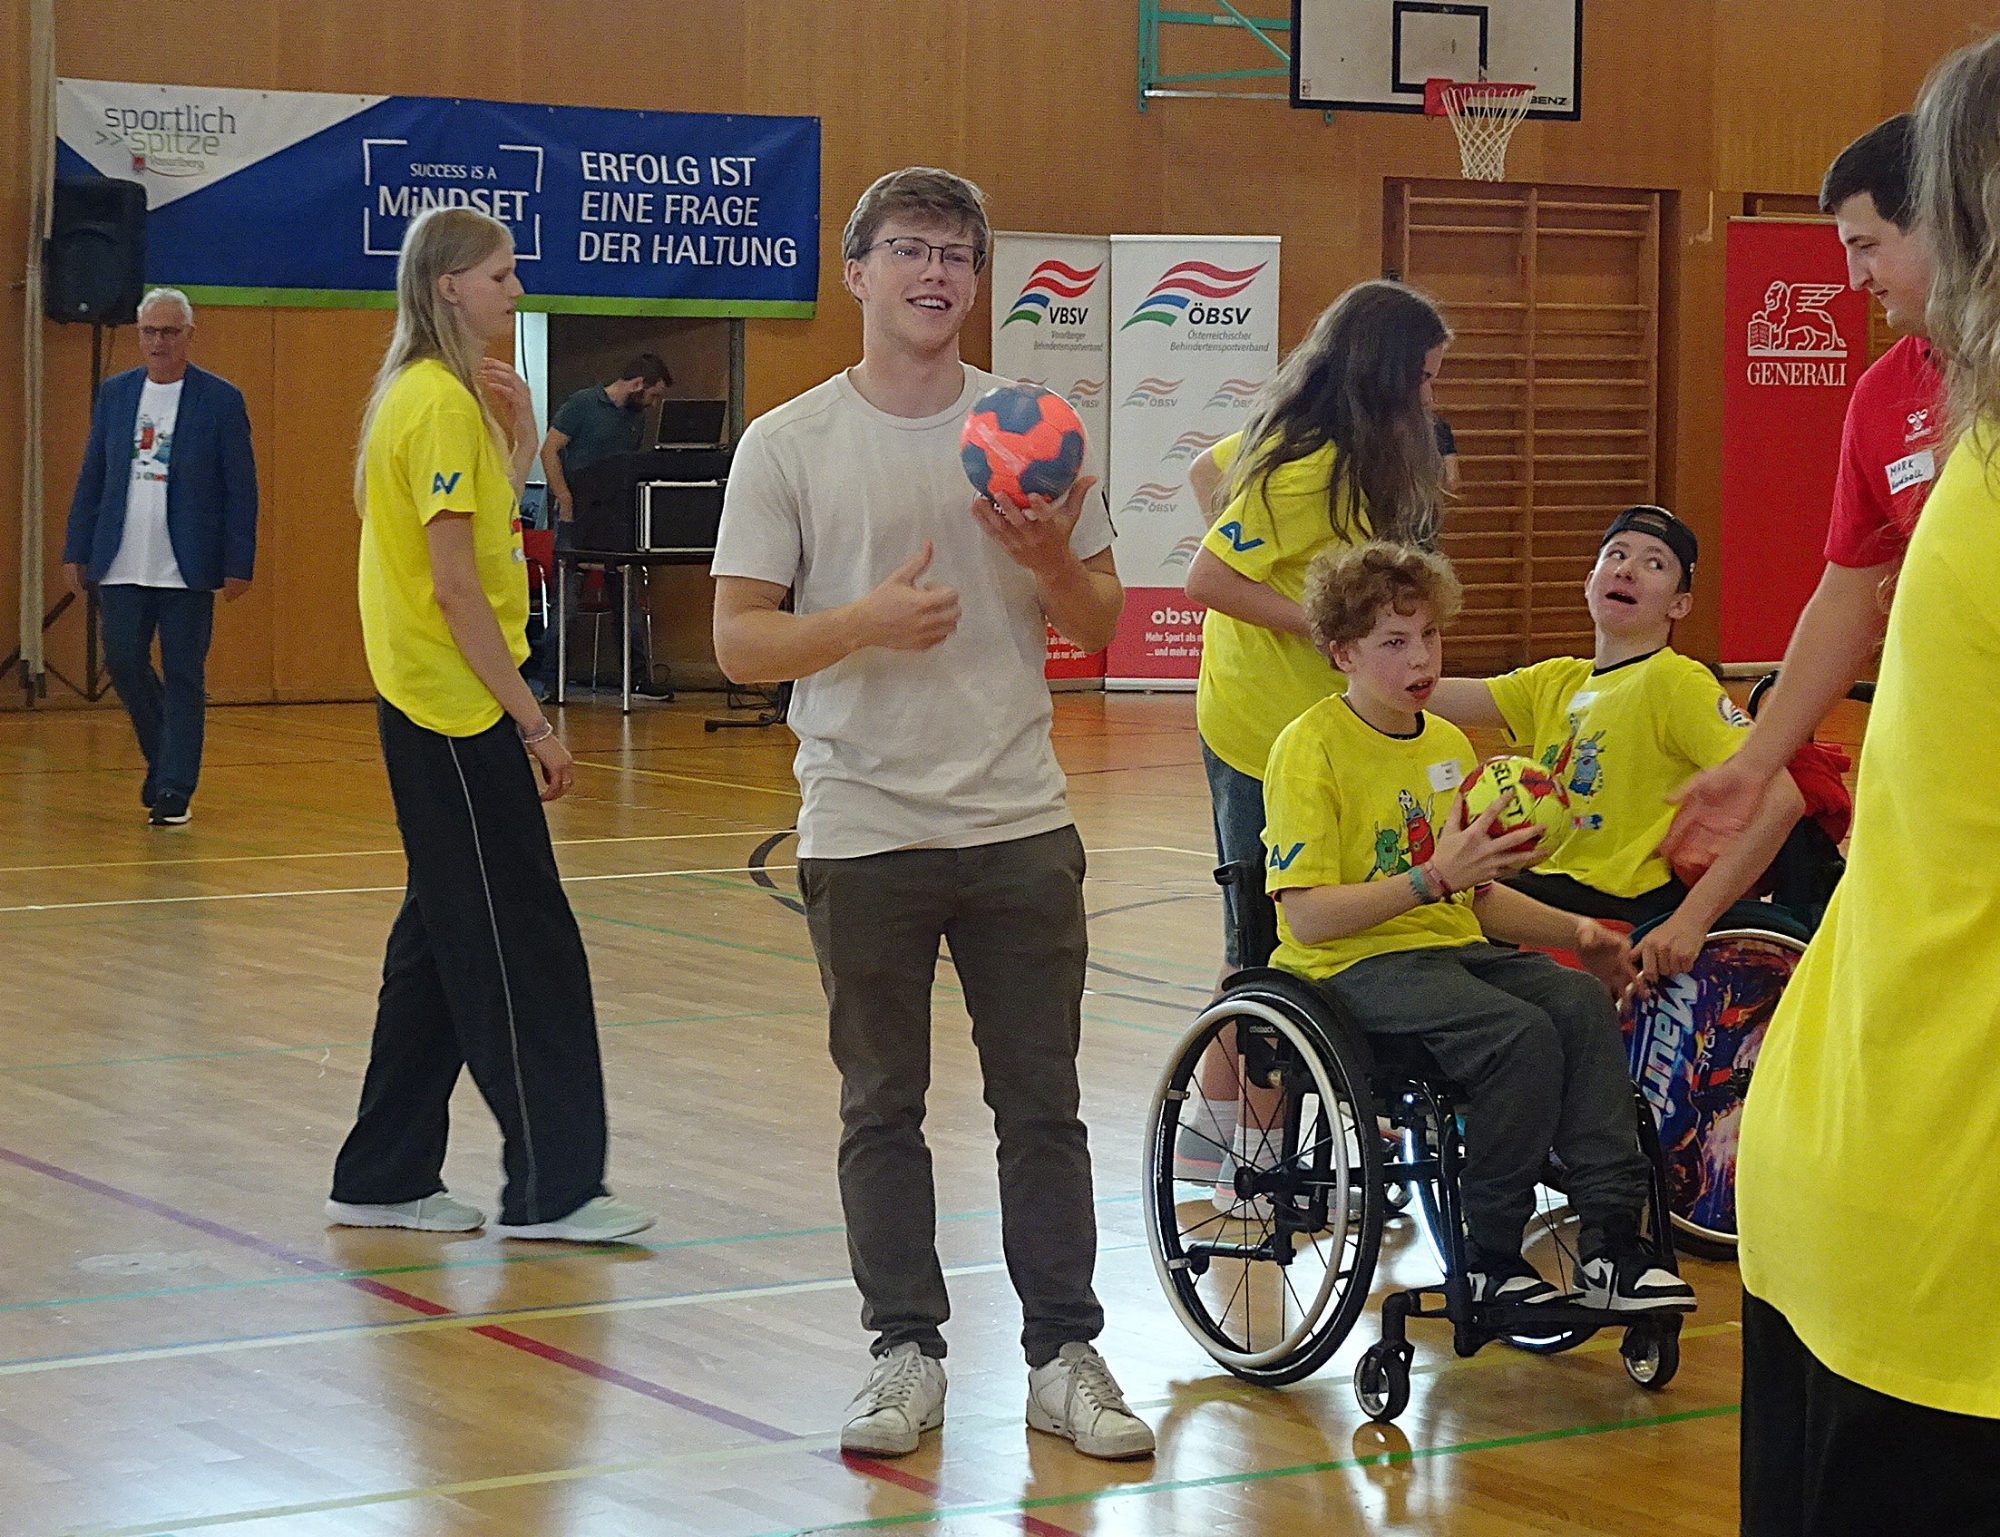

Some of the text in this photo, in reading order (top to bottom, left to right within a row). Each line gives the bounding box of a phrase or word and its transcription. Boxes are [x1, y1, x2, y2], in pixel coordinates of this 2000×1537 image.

[104, 104, 237, 136] sportlich
[130, 129, 220, 156] spitze
[410, 162, 467, 179] SUCCESS
[487, 166, 497, 180] A
[581, 151, 757, 187] ERFOLG IST
[581, 192, 760, 227] EINE FRAGE
[578, 231, 798, 267] DER HALTUNG
[1049, 306, 1089, 325] VBSV
[1188, 302, 1252, 325] ÖBSV
[1187, 329, 1252, 341] Österreichischer
[1169, 341, 1270, 353] Behindertensportverband
[1746, 362, 1848, 387] GENERALI
[1164, 632, 1184, 644] Sport
[1154, 646, 1169, 656] und
[1169, 646, 1188, 656] mehr
[1188, 647, 1200, 657] als
